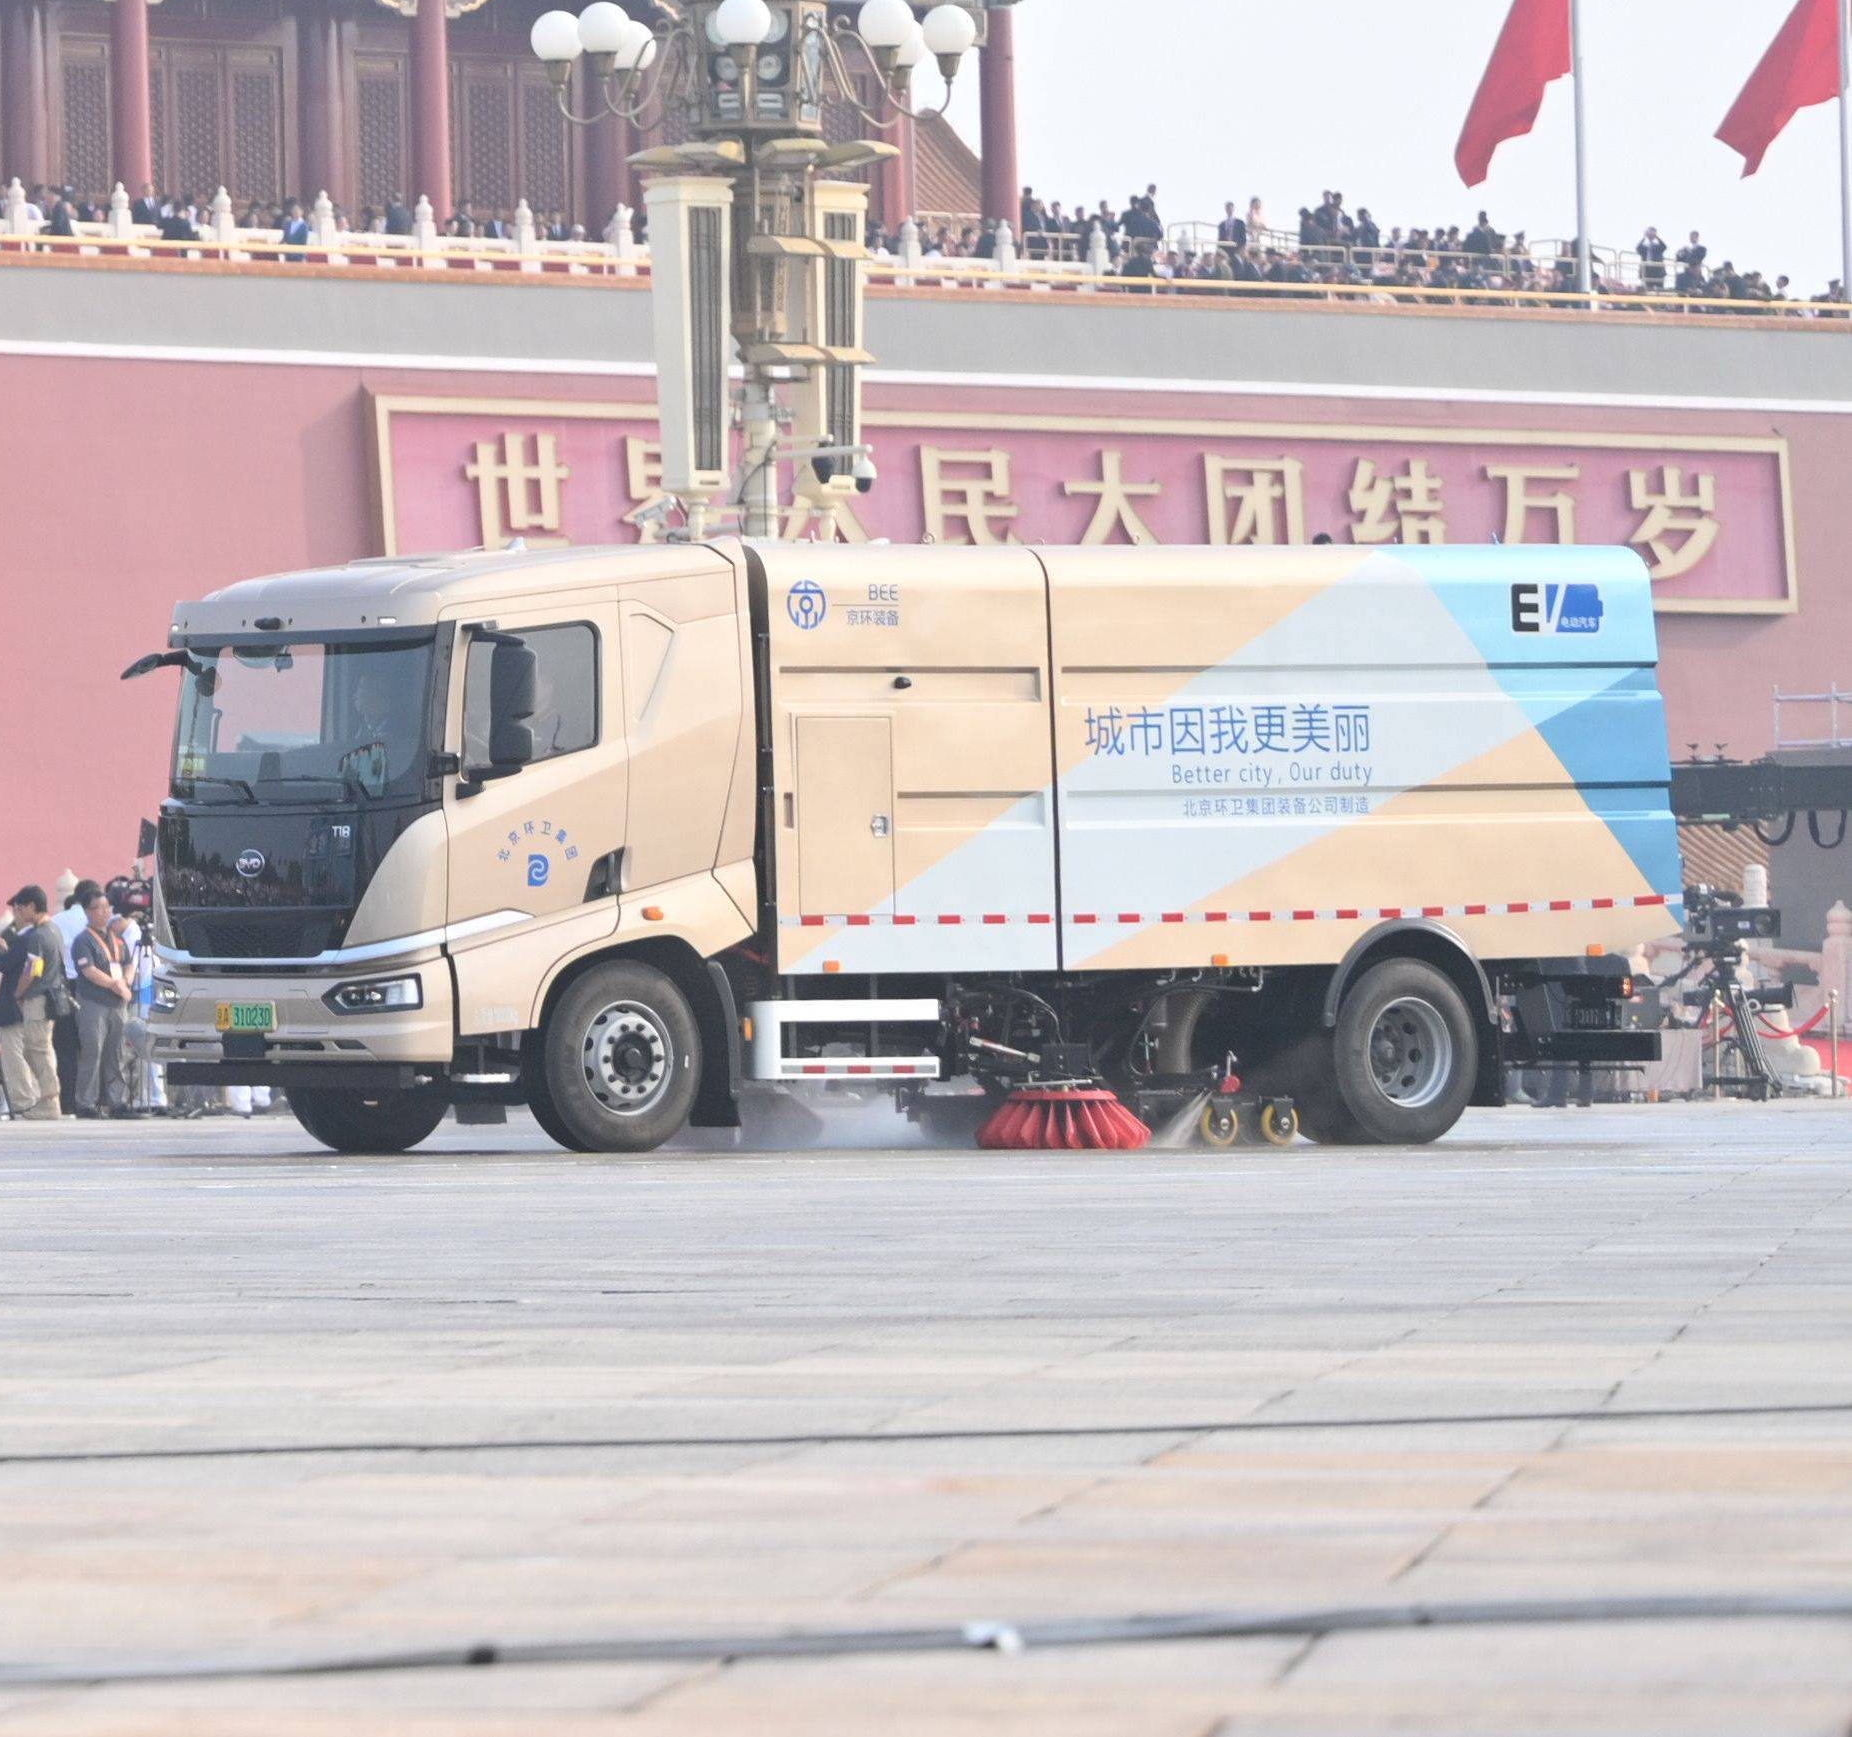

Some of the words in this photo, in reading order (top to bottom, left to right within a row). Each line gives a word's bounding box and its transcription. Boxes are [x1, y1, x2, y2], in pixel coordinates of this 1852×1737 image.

[868, 583, 899, 601] BEE
[846, 610, 899, 626] 京环装备
[1511, 583, 1568, 632] EV
[1084, 703, 1370, 756] 城市因我更美丽
[1172, 764, 1232, 784] Better
[1289, 761, 1322, 781] Our
[1330, 760, 1373, 787] duty
[1183, 796, 1370, 817] 北京环卫集团装备公司制造
